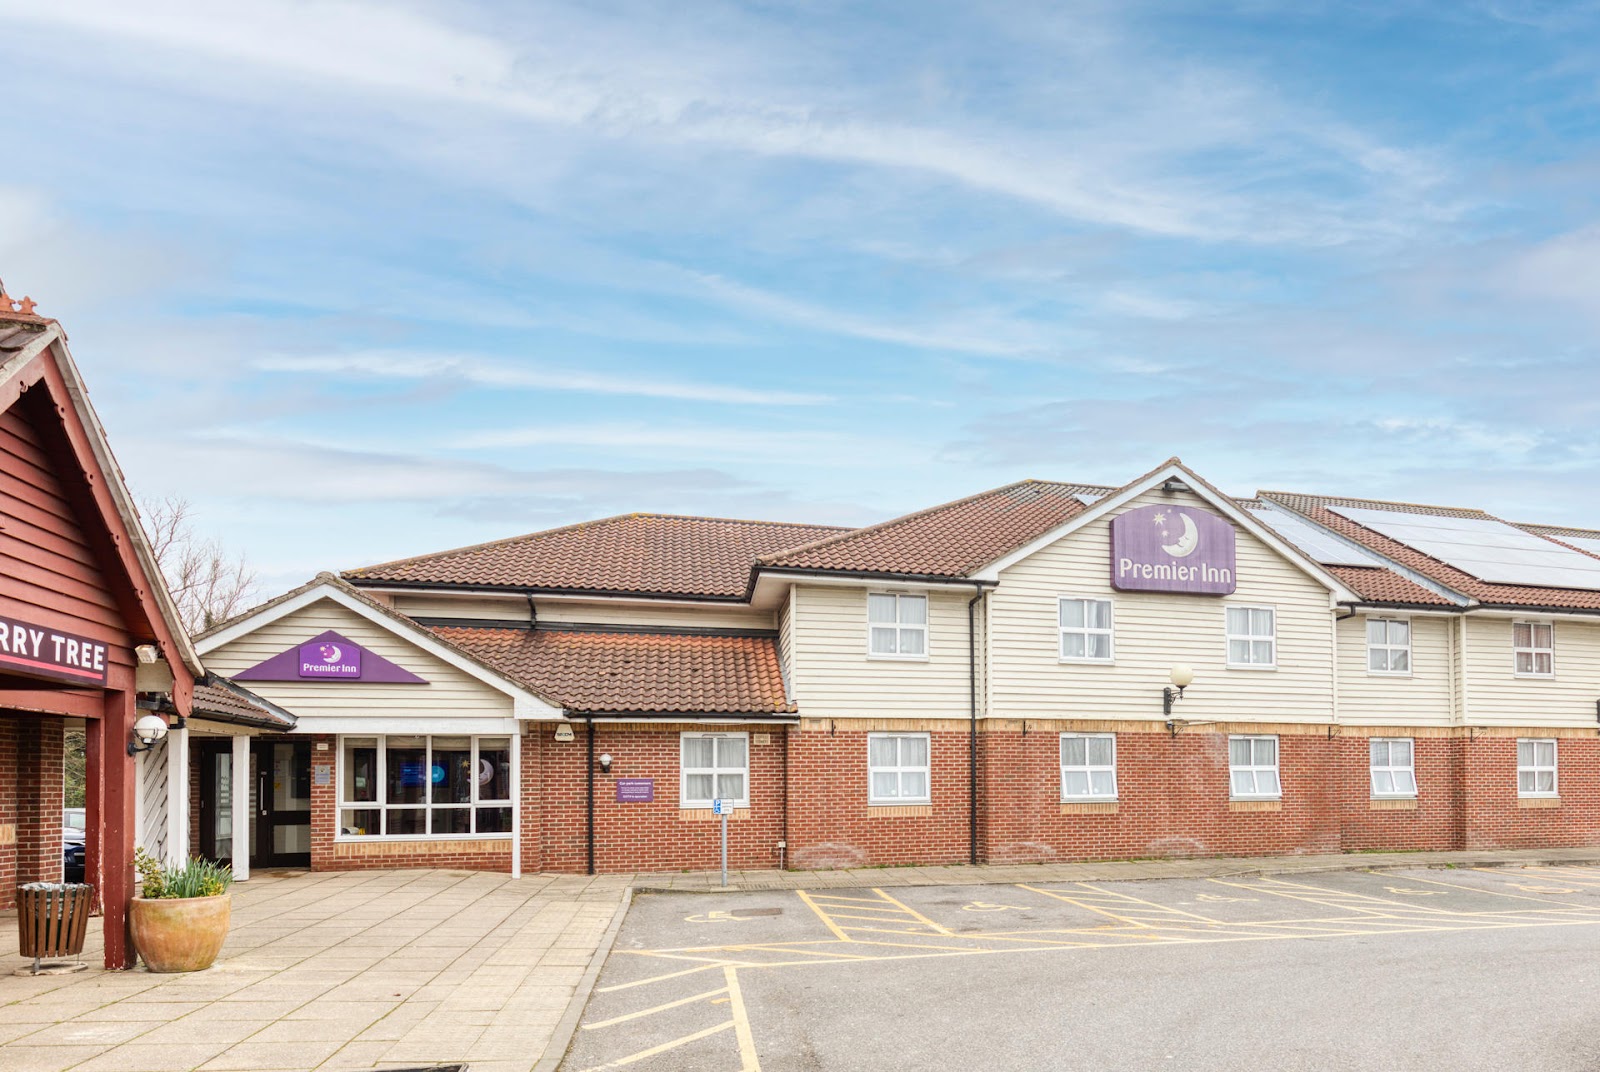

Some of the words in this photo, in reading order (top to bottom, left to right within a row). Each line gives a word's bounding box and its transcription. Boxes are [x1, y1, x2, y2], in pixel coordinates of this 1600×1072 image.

[1120, 558, 1198, 581] Premier
[1202, 563, 1231, 583] Inn
[51, 634, 104, 671] TREE
[303, 663, 341, 672] Premier
[342, 664, 357, 673] Inn
